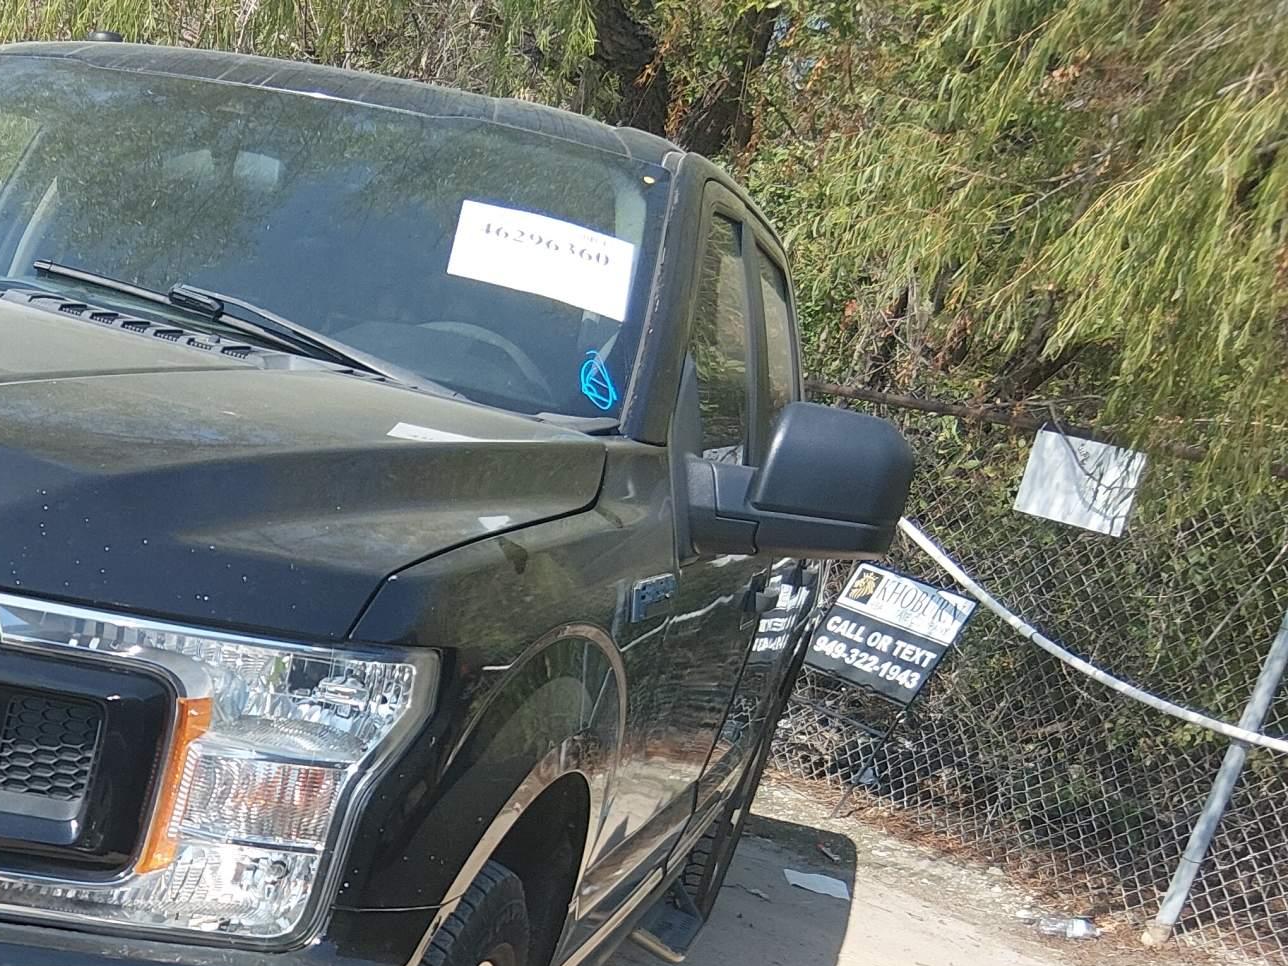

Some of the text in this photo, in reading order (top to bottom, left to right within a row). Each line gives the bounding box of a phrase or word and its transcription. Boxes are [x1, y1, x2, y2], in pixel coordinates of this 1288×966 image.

[813, 635, 922, 689] 949-322-1943
[826, 615, 867, 644] CALL
[867, 631, 895, 653] OR
[892, 639, 937, 668] TEXT
